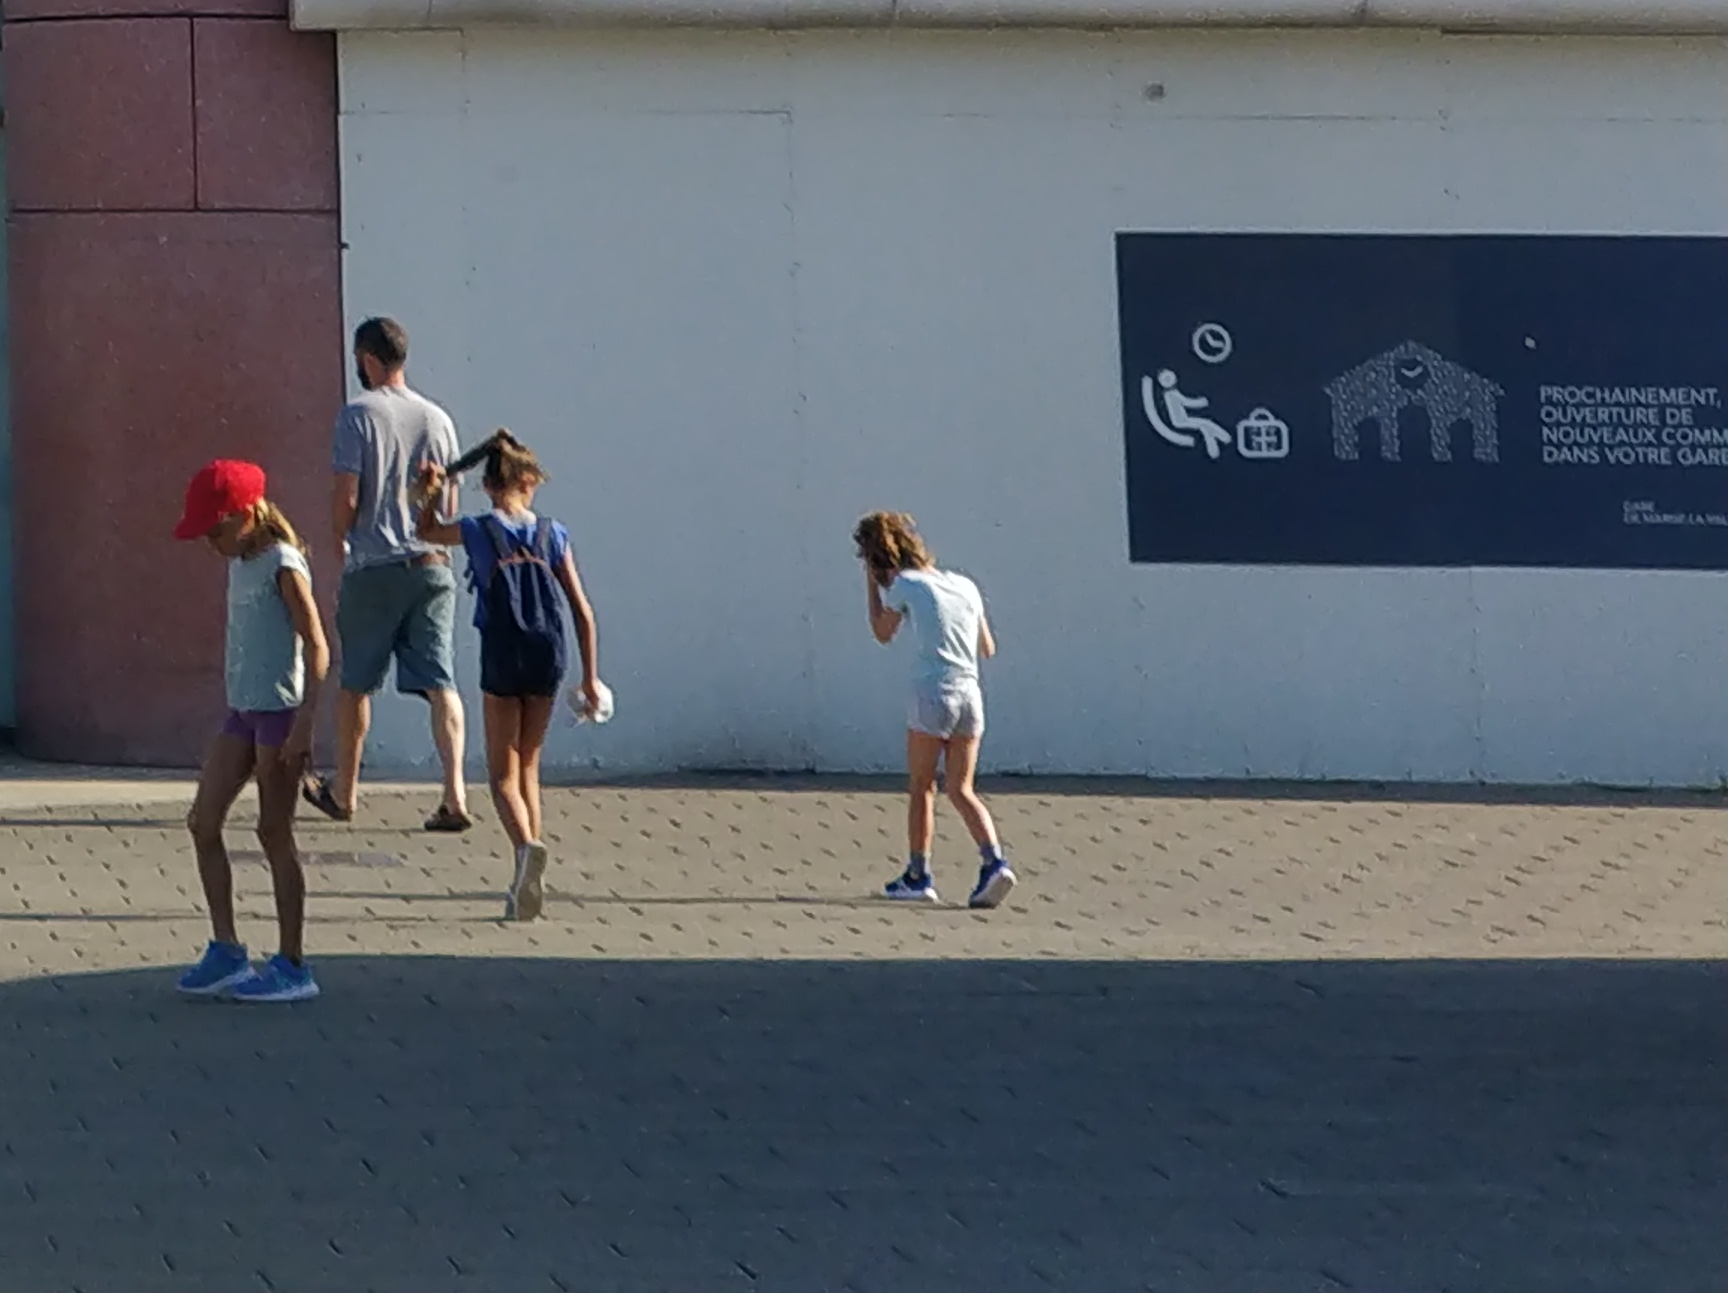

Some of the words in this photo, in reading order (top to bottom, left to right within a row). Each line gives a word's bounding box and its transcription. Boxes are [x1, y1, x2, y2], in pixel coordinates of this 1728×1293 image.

[1539, 385, 1723, 409] PROCHAINEMENT,
[1540, 405, 1661, 426] OUVERTURE
[1665, 407, 1694, 426] DE
[1541, 426, 1658, 445] NOUVEAUX
[1542, 445, 1600, 465] DANS
[1604, 446, 1672, 466] VOTRE
